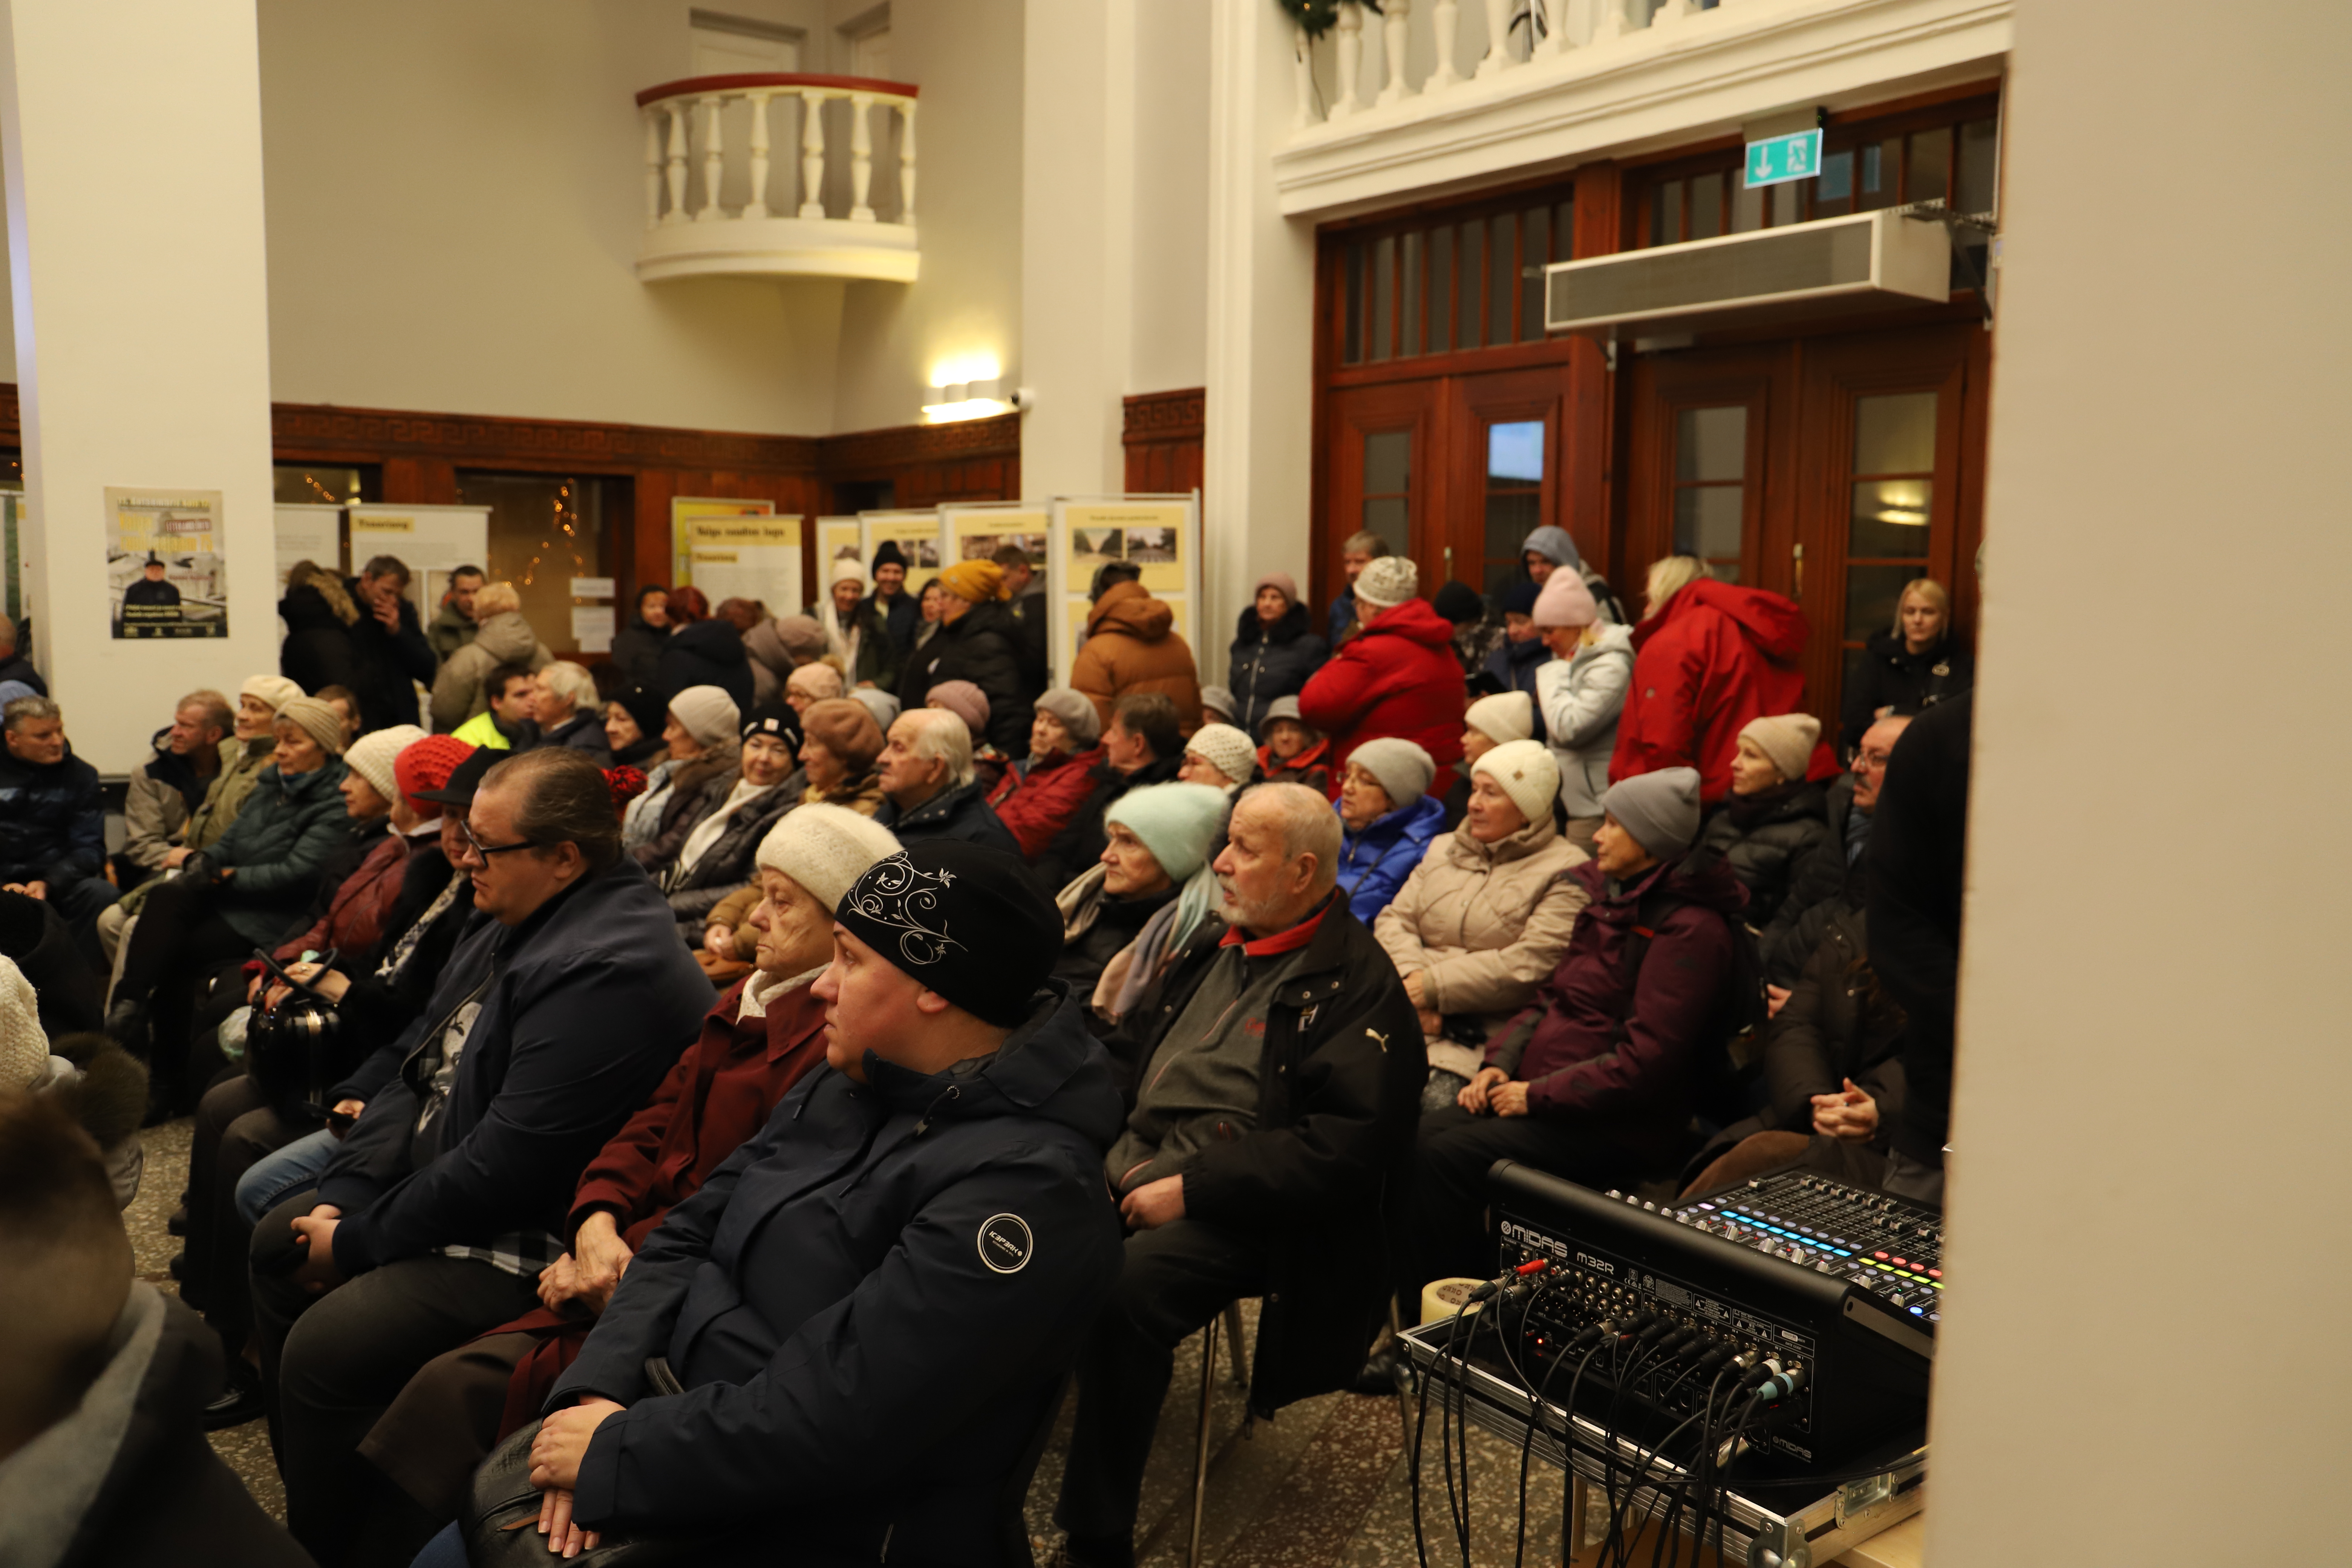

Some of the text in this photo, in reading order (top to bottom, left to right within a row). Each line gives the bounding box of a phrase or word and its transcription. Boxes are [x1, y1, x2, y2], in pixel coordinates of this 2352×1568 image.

[1512, 1224, 1568, 1258] MIDAS
[1577, 1252, 1614, 1275] M32R
[1779, 1438, 1811, 1459] MIDAS
